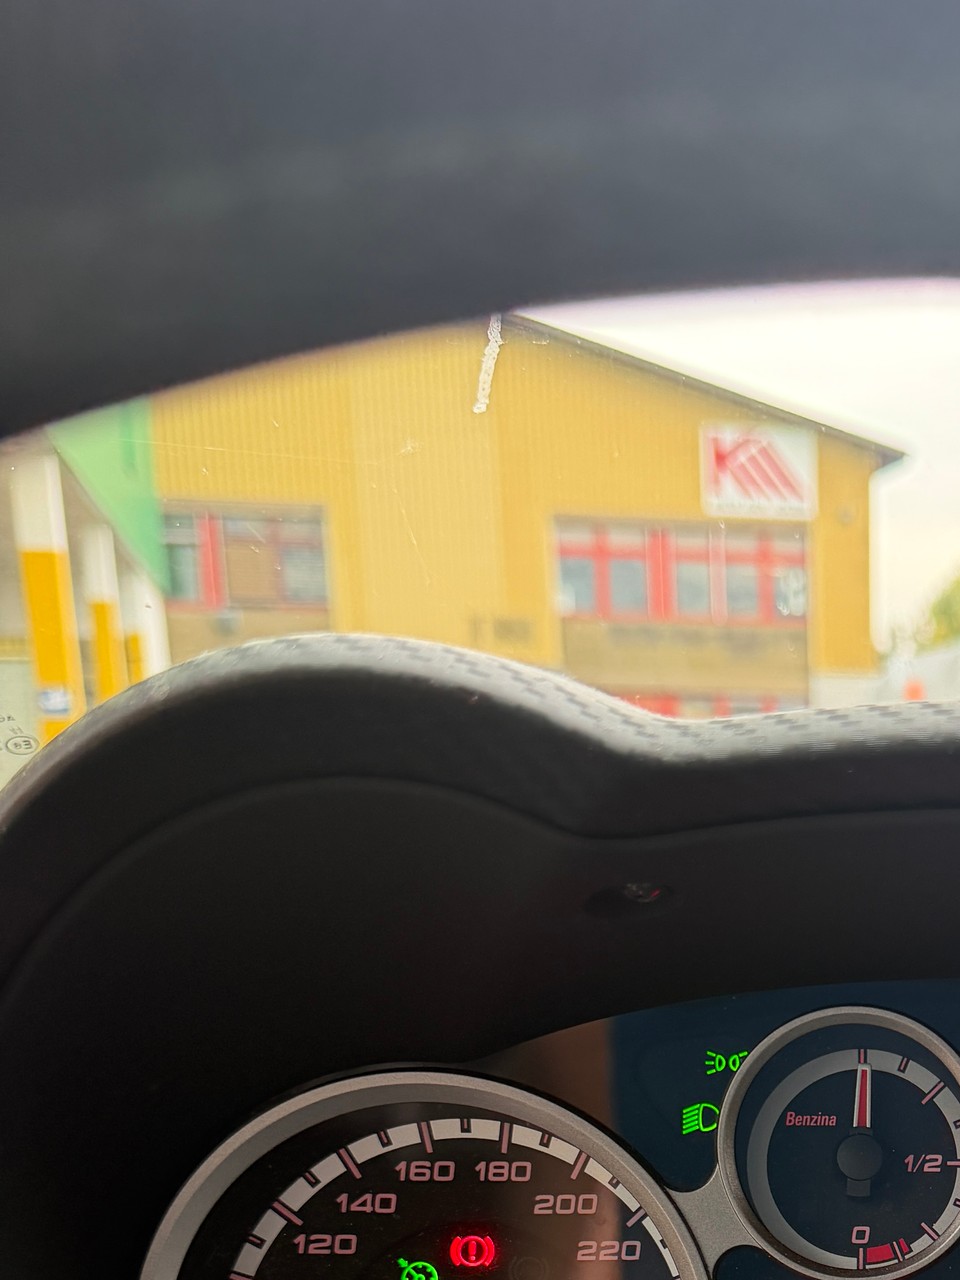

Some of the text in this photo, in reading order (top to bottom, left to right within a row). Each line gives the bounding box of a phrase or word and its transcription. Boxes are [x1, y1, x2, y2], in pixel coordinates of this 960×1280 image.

[785, 1111, 837, 1127] Benzina
[395, 1161, 455, 1182] 160
[475, 1161, 532, 1182] 180
[904, 1154, 942, 1173] 1/2
[336, 1193, 397, 1213] 140
[533, 1194, 598, 1215] 200
[293, 1234, 357, 1254] 120
[851, 1226, 870, 1244] 0
[577, 1241, 641, 1261] 220
